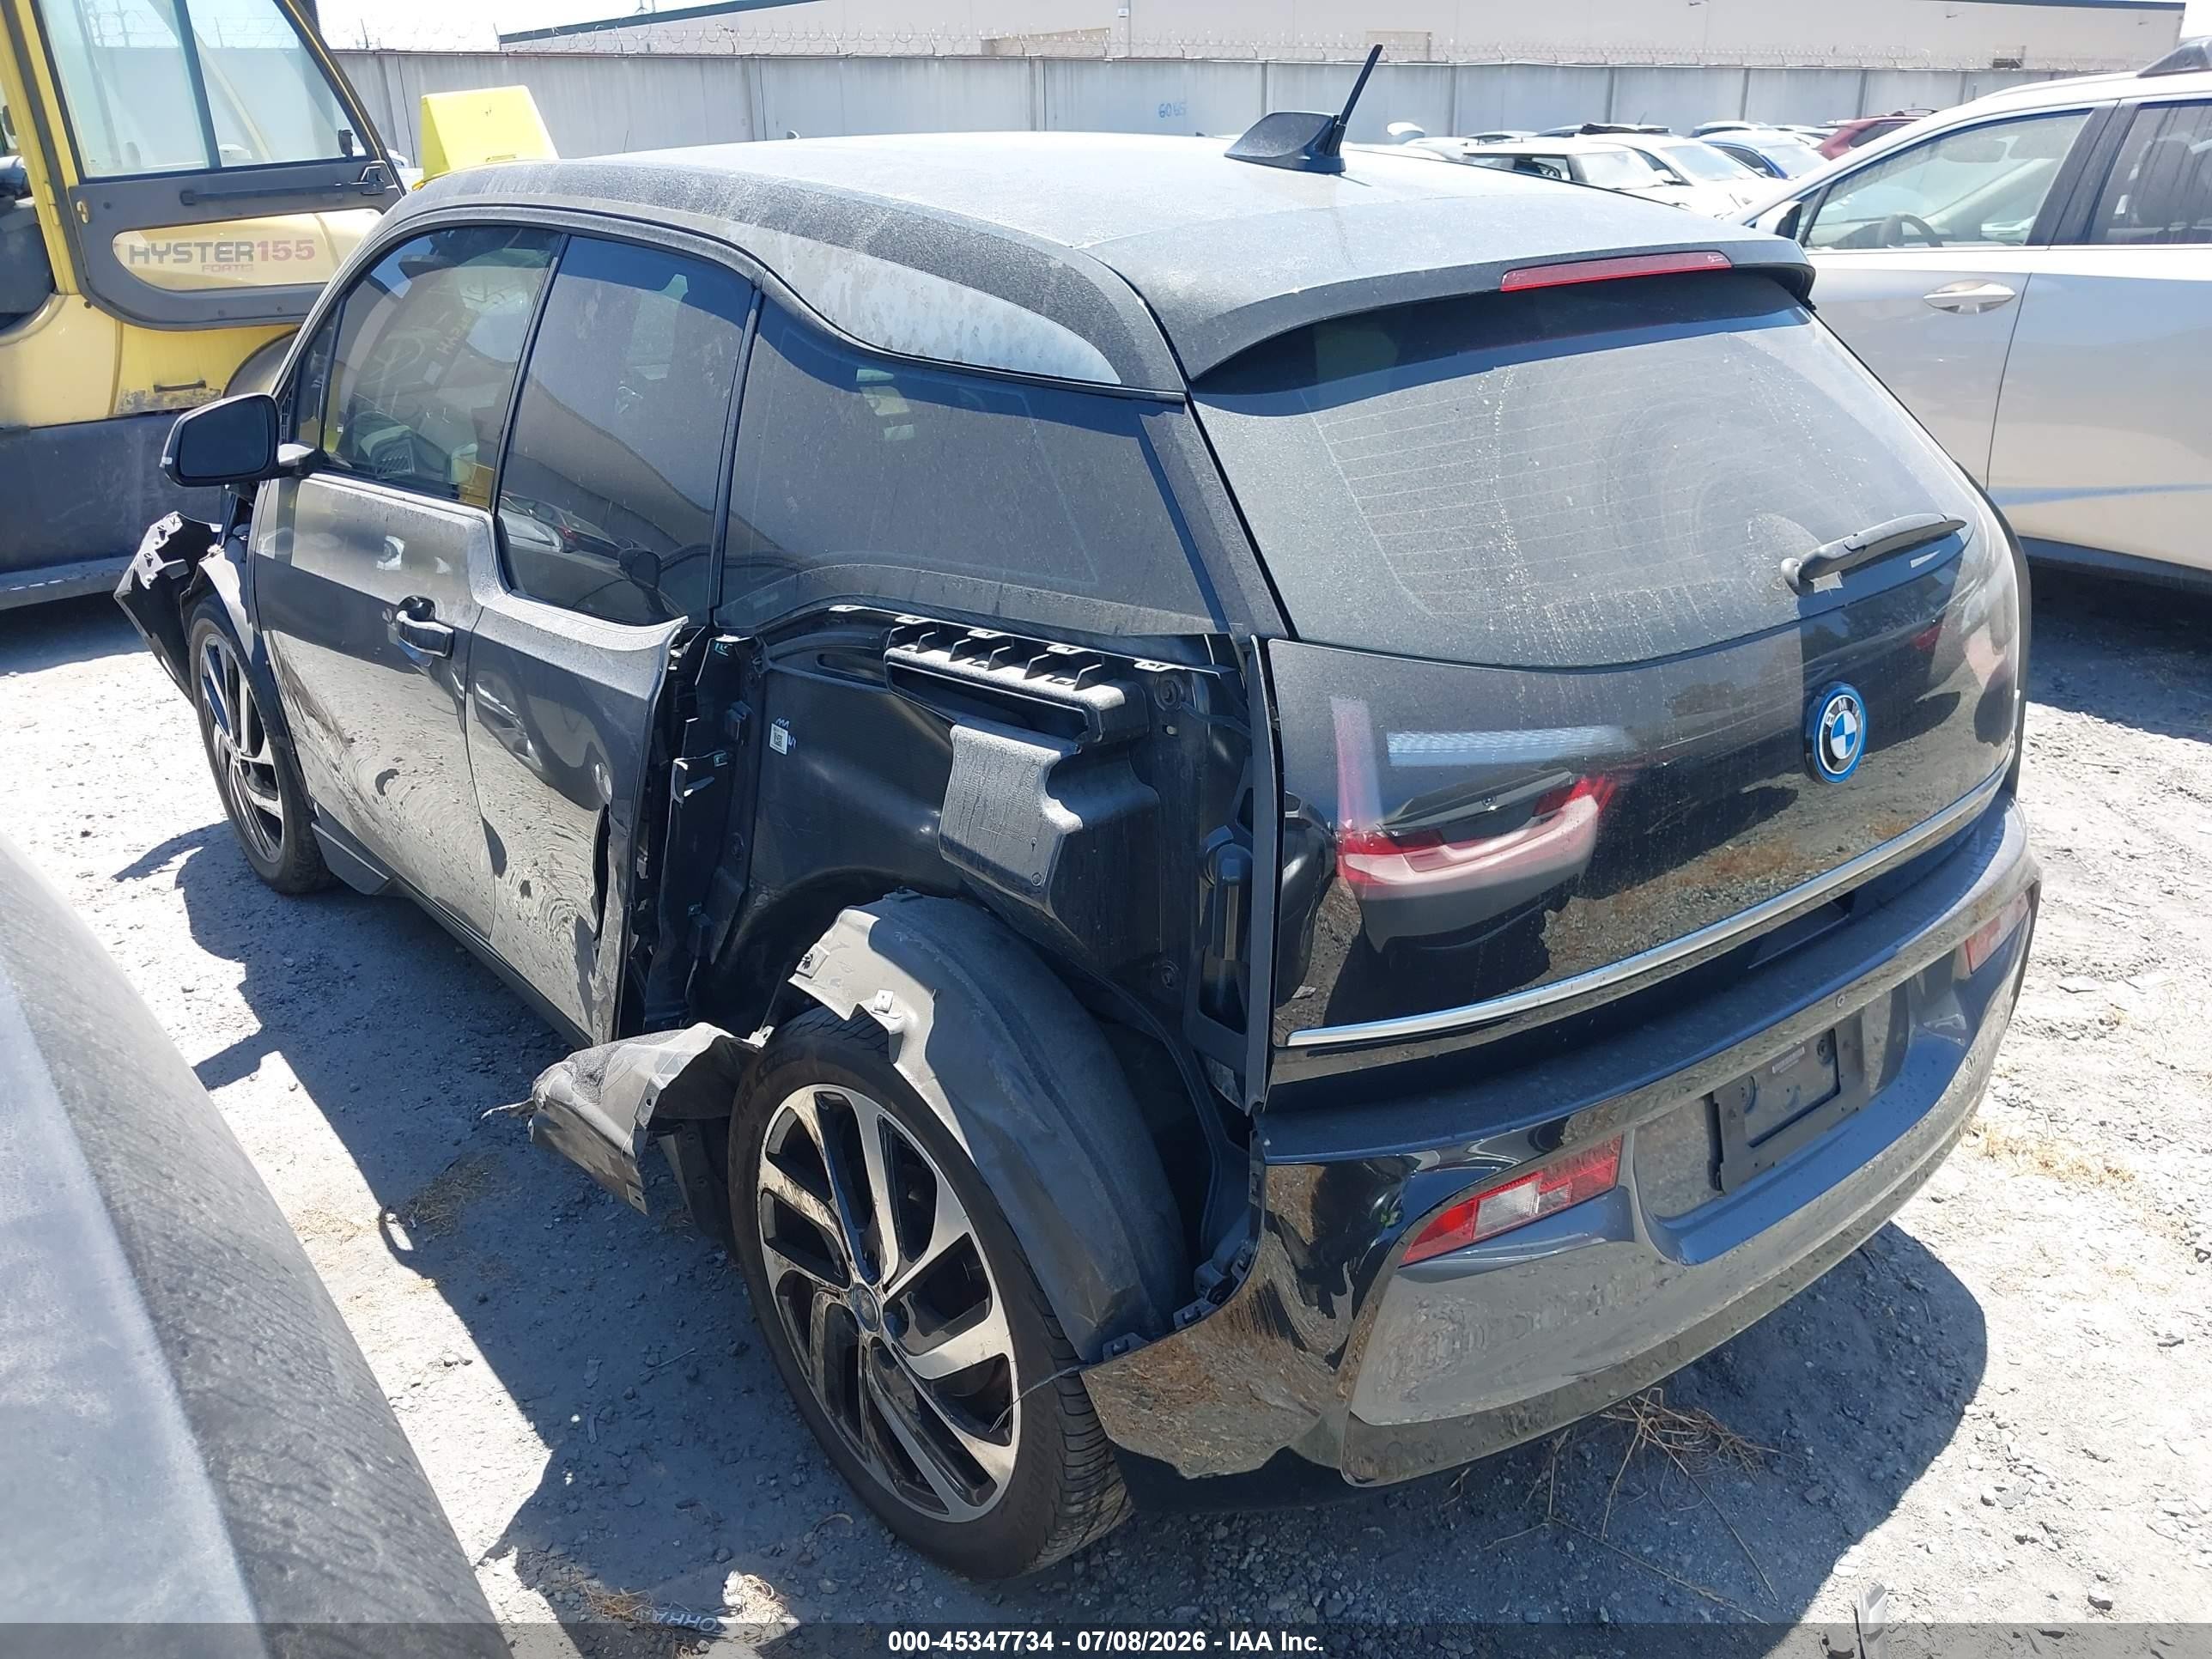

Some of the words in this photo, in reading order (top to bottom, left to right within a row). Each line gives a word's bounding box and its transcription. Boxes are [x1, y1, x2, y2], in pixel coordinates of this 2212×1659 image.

[130, 241, 254, 264] HYSTER
[257, 239, 316, 262] 155
[1825, 697, 1861, 728] BMW
